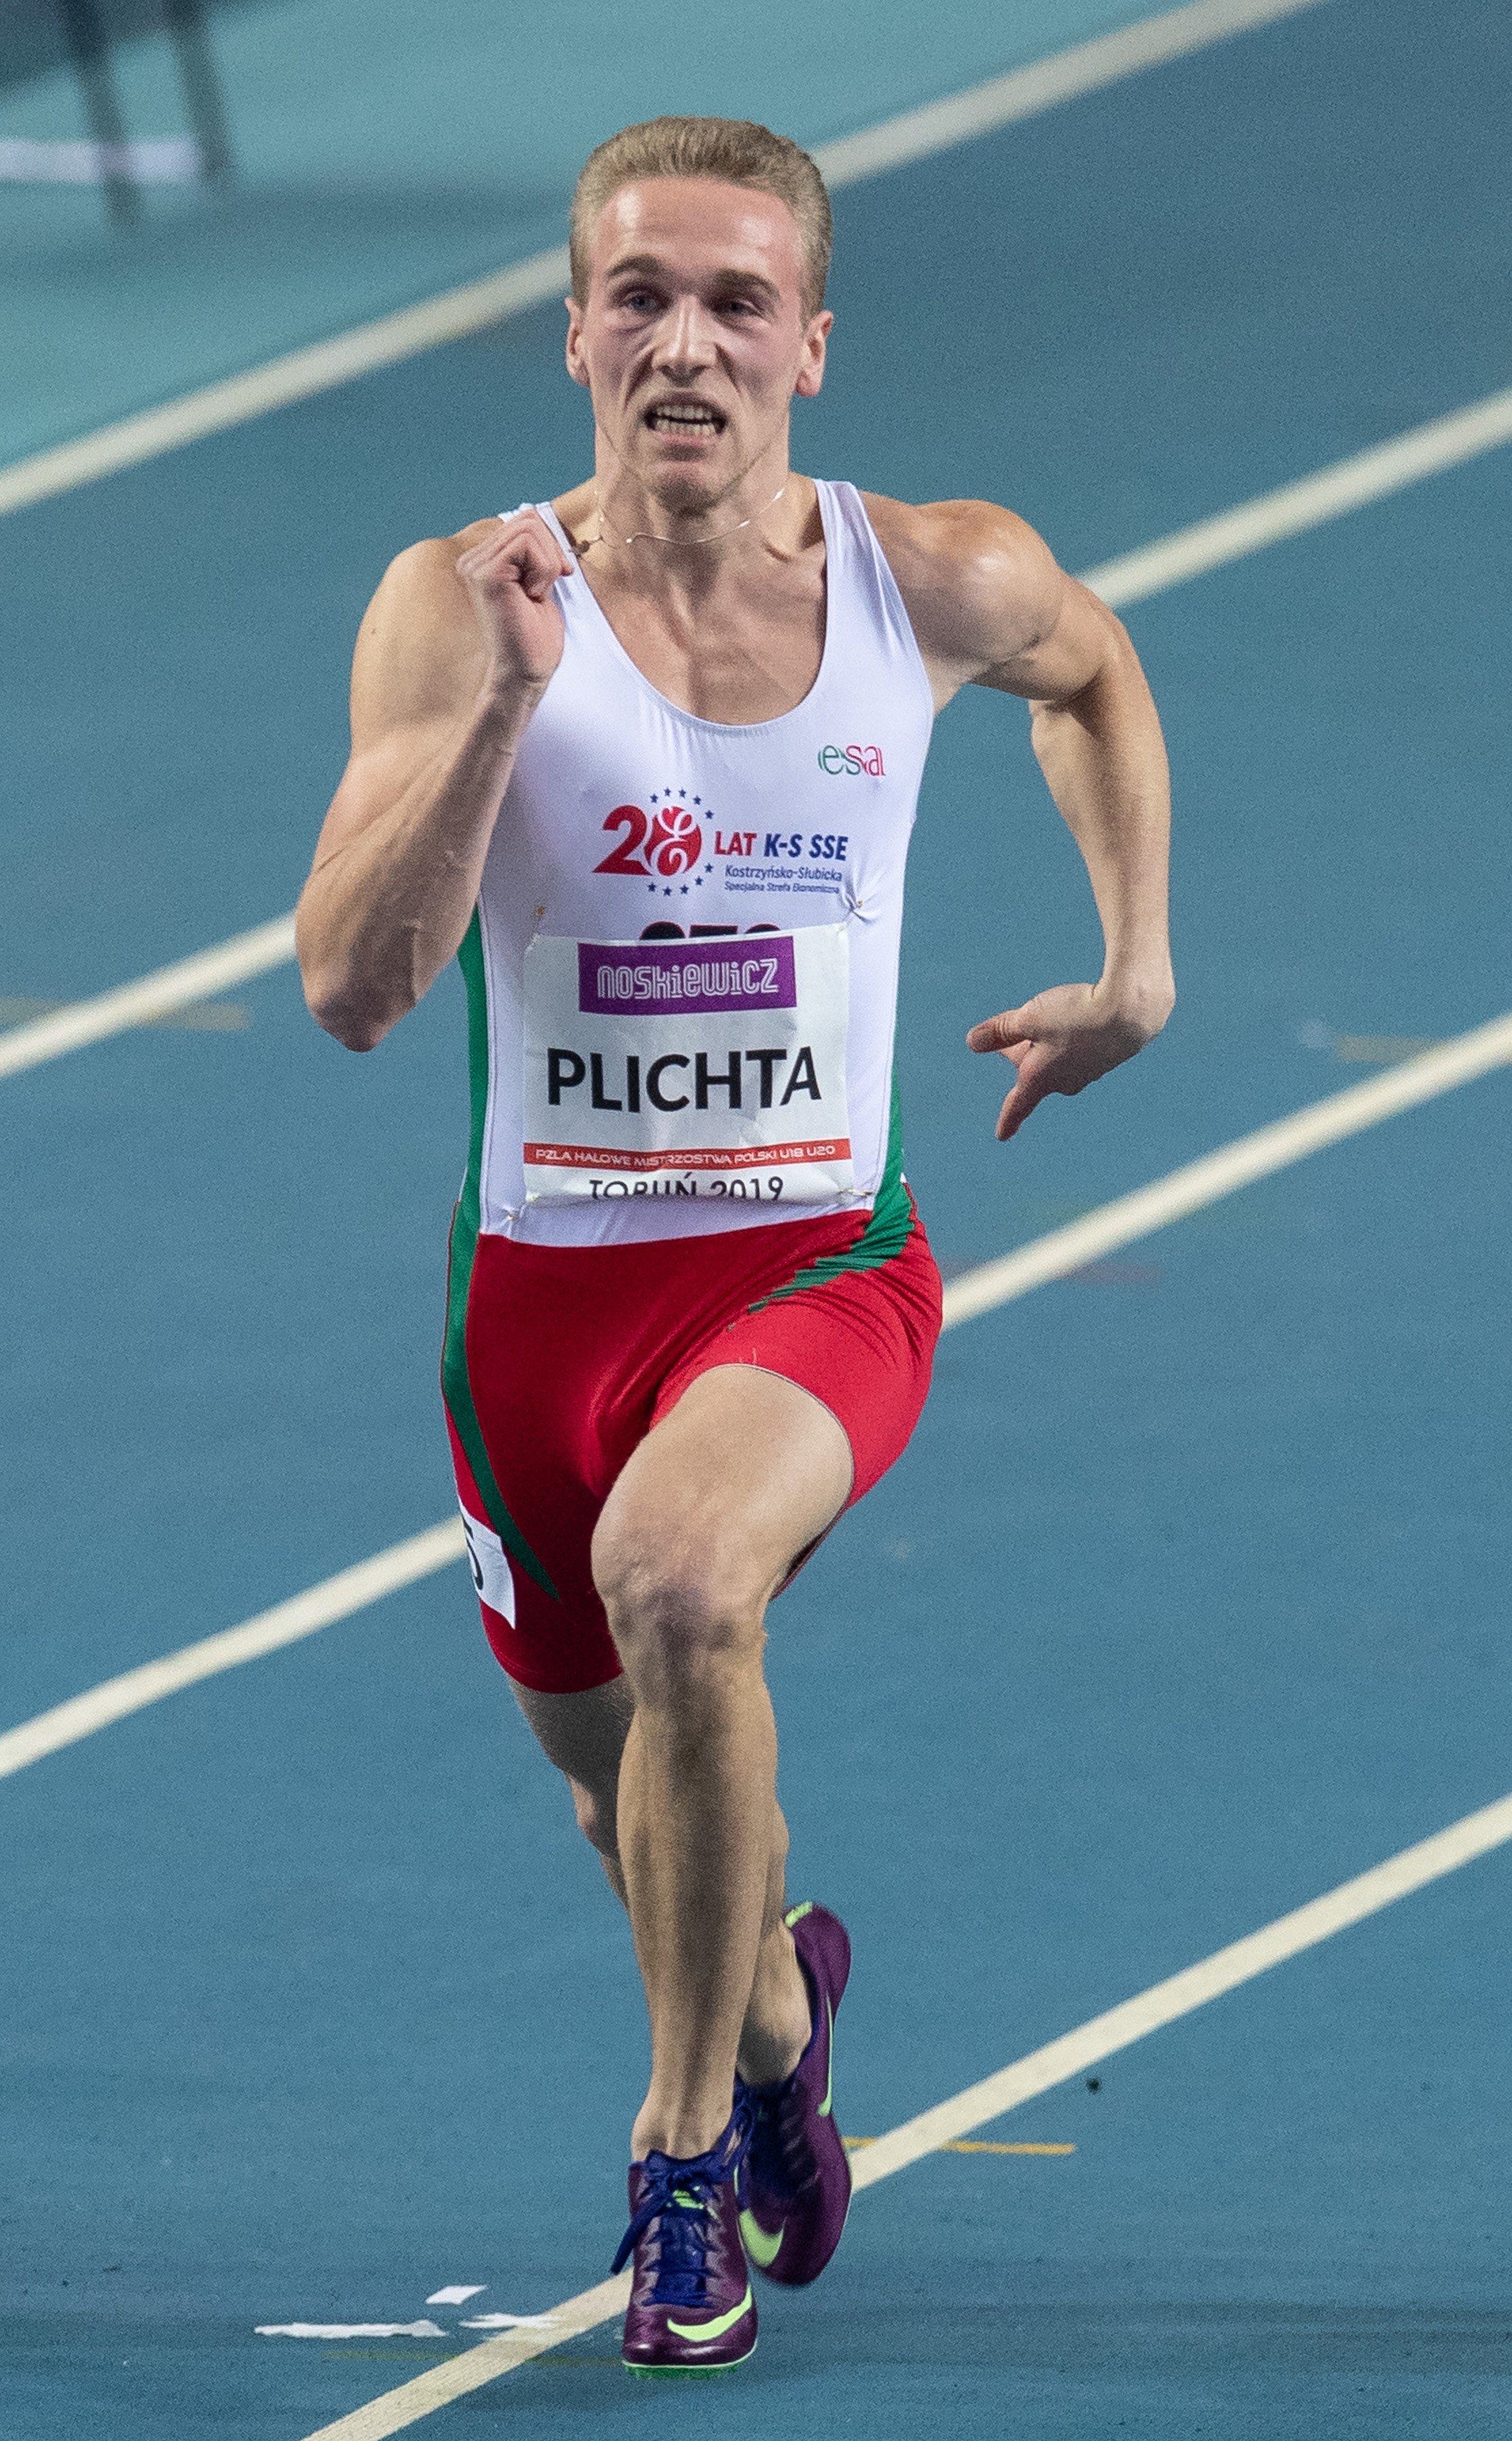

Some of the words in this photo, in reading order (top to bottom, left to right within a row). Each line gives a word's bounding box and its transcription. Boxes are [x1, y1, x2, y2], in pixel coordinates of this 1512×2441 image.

[817, 745, 886, 776] esa
[714, 831, 757, 856] LAT
[763, 833, 803, 857] K-S
[809, 834, 848, 861] SSE
[724, 865, 842, 881] Kostrzyńsko-Słubicka
[547, 1046, 823, 1113] PLICHTA
[535, 1149, 571, 1160] PZLA
[573, 1151, 631, 1166] HALOWE
[633, 1154, 731, 1167] MISTRZOSTWA
[734, 1151, 776, 1164] POLSKI
[780, 1148, 804, 1159] U18
[806, 1145, 835, 1157] U20
